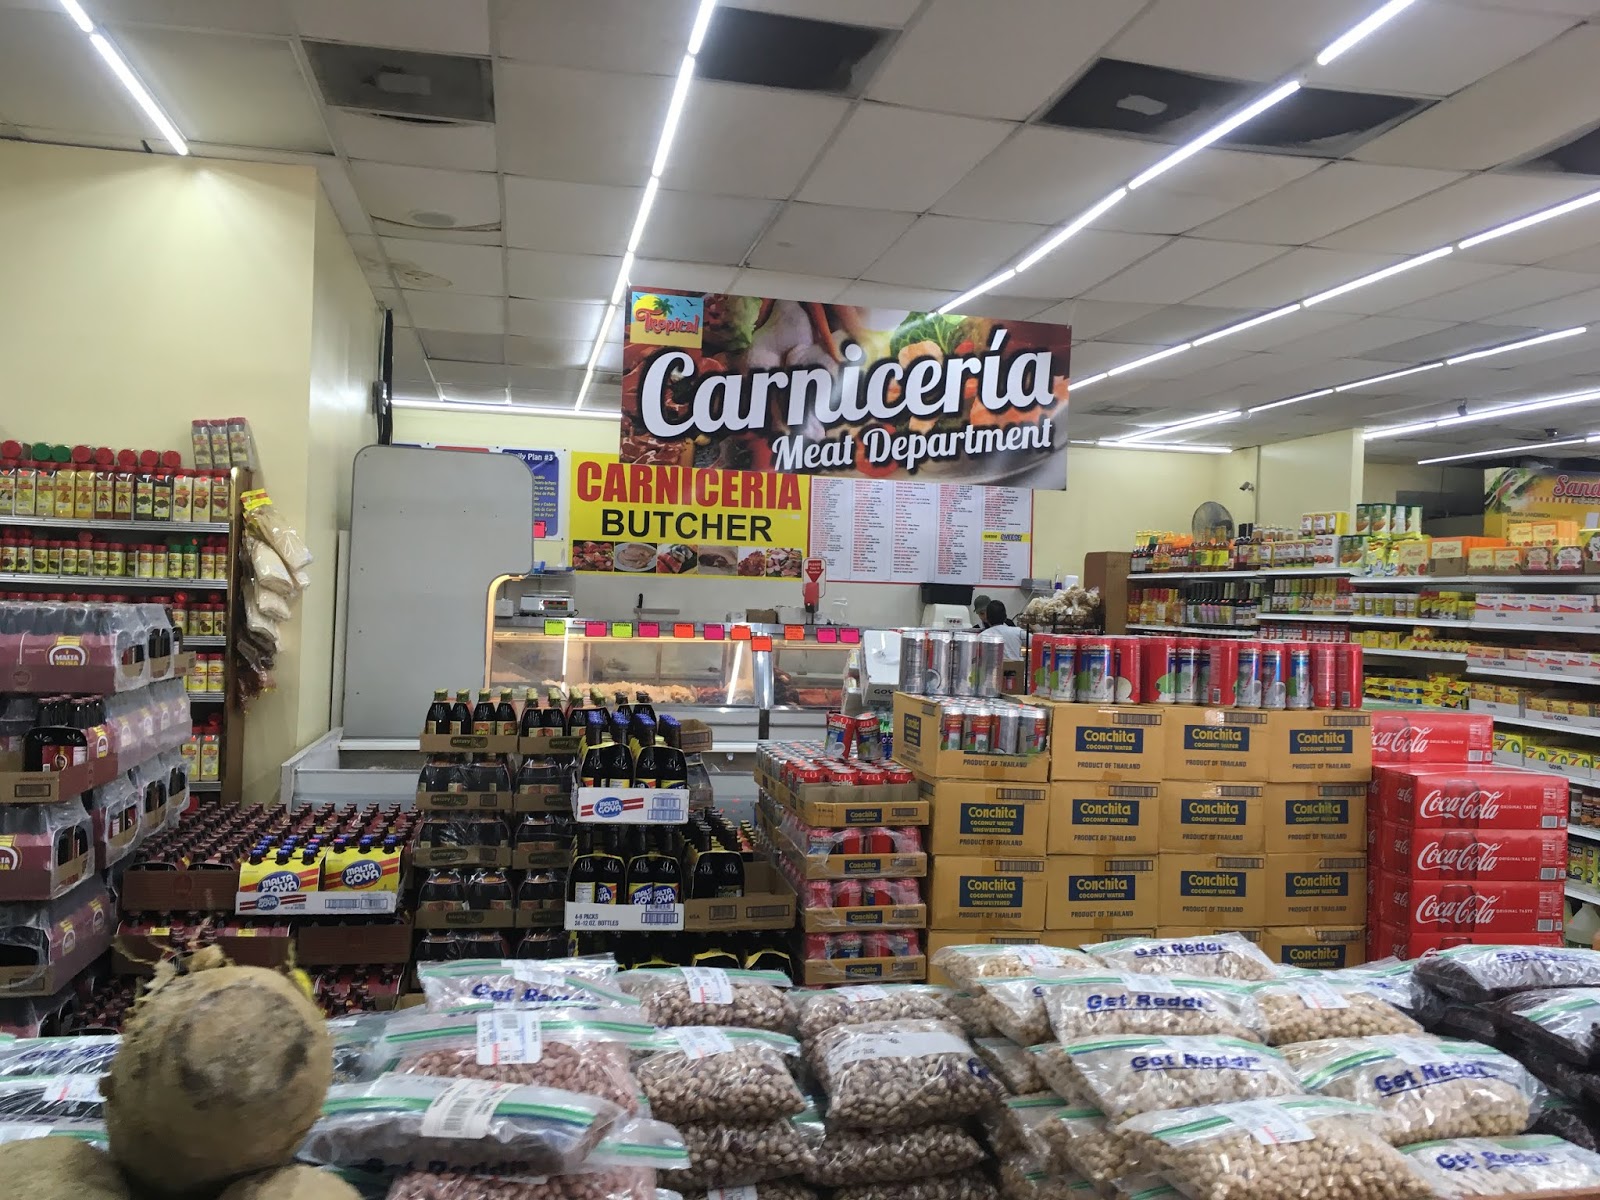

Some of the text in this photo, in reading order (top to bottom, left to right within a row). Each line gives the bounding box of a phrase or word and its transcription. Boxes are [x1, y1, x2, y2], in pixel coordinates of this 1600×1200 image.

[634, 306, 699, 335] Tropical
[641, 329, 1056, 438] Carnicería
[772, 417, 1053, 471] Meat Department
[527, 453, 543, 461] Plan
[577, 461, 803, 510] CARNICERIA
[602, 509, 772, 542] BUTCHER
[1083, 730, 1136, 743] Conchita
[1191, 728, 1242, 741] Conchita
[1297, 732, 1346, 744] Conchita
[1371, 726, 1433, 753] oca-Cola
[1077, 761, 1103, 769] PRODUCT
[598, 805, 622, 814] GOYA
[1080, 802, 1131, 815] Conchita
[1189, 802, 1239, 815] Conchita
[1293, 802, 1341, 815] Conchita
[1420, 790, 1504, 819] Coca-Cola
[968, 806, 1017, 819] Conchita
[1417, 842, 1503, 871] Coca-Cola
[346, 863, 375, 875] MALTA
[262, 874, 293, 887] MALTA
[345, 869, 380, 885] GOYA
[1188, 875, 1238, 887] Conchita
[1293, 875, 1341, 887] Conchita
[261, 881, 298, 892] GOYA
[967, 879, 1016, 891] Conchita
[1076, 879, 1128, 891] Conchita
[655, 891, 675, 903] OYA
[1416, 895, 1500, 924] Coca-Cola
[1289, 948, 1339, 960] Conchita
[1087, 994, 1127, 1009] Get
[1374, 1068, 1417, 1092] Get
[1436, 1152, 1475, 1170] Get
